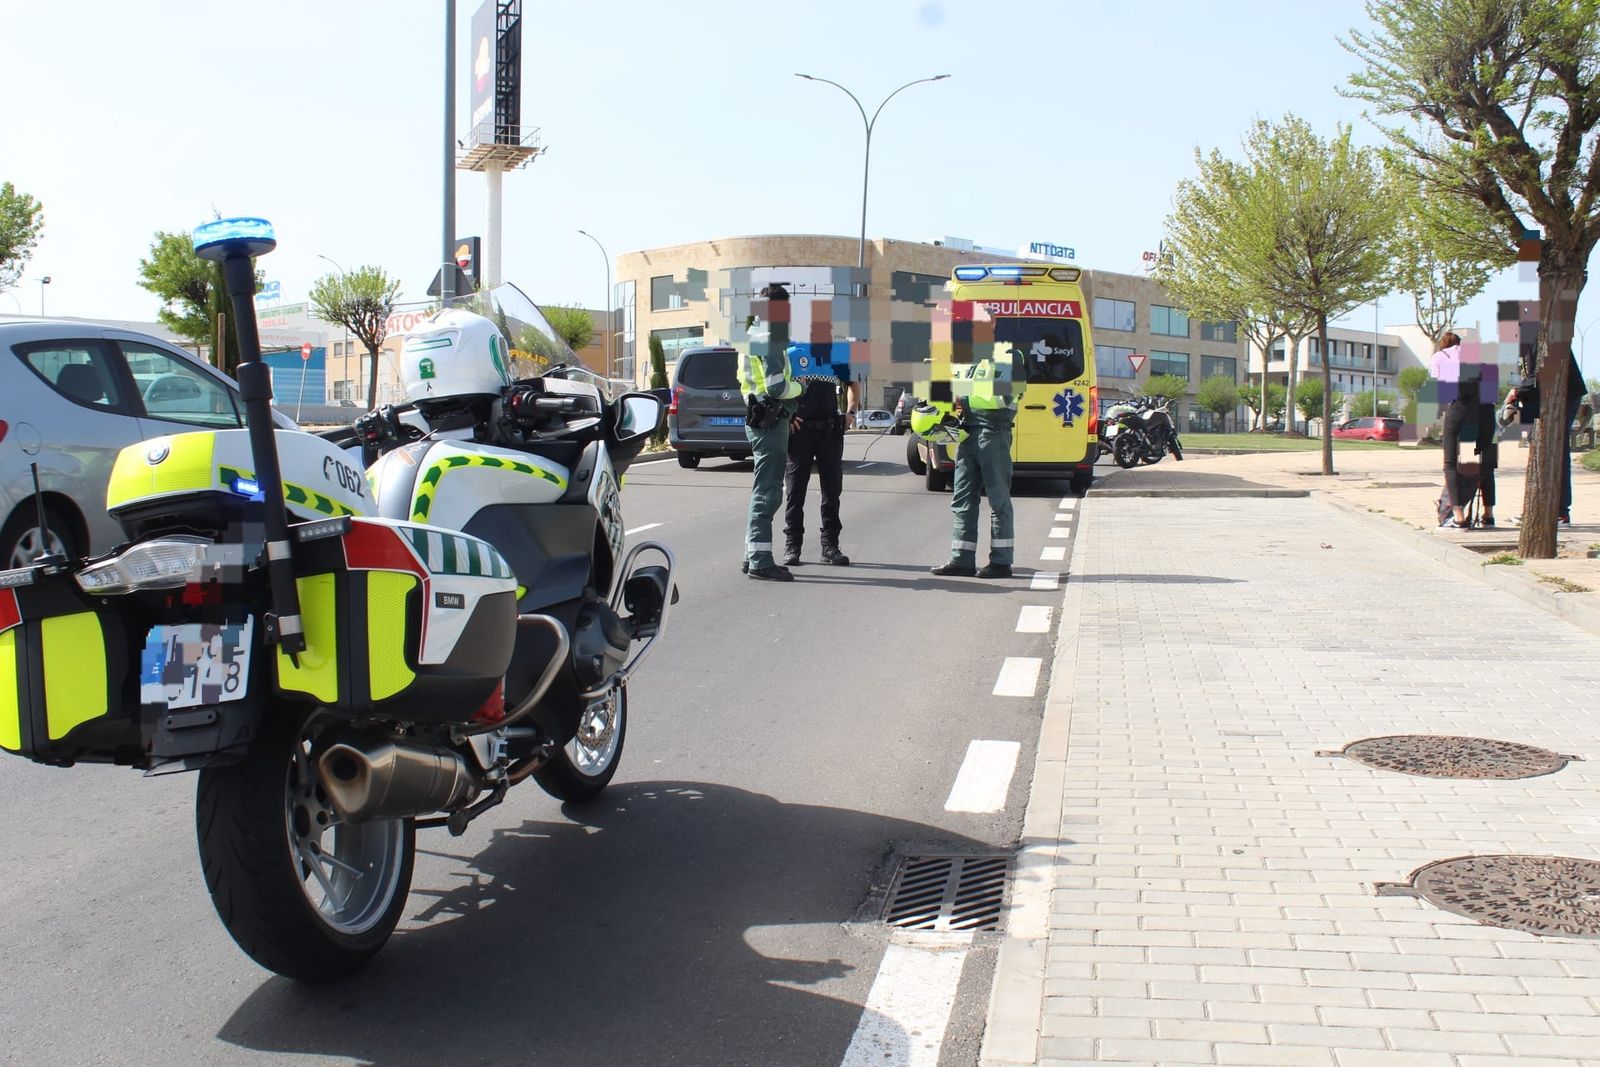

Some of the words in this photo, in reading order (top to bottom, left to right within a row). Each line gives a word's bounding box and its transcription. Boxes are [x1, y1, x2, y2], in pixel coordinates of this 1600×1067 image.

[990, 302, 1074, 316] BULANCIA
[1053, 347, 1074, 357] Sacyl
[335, 460, 365, 498] 062
[443, 595, 460, 606] BMW
